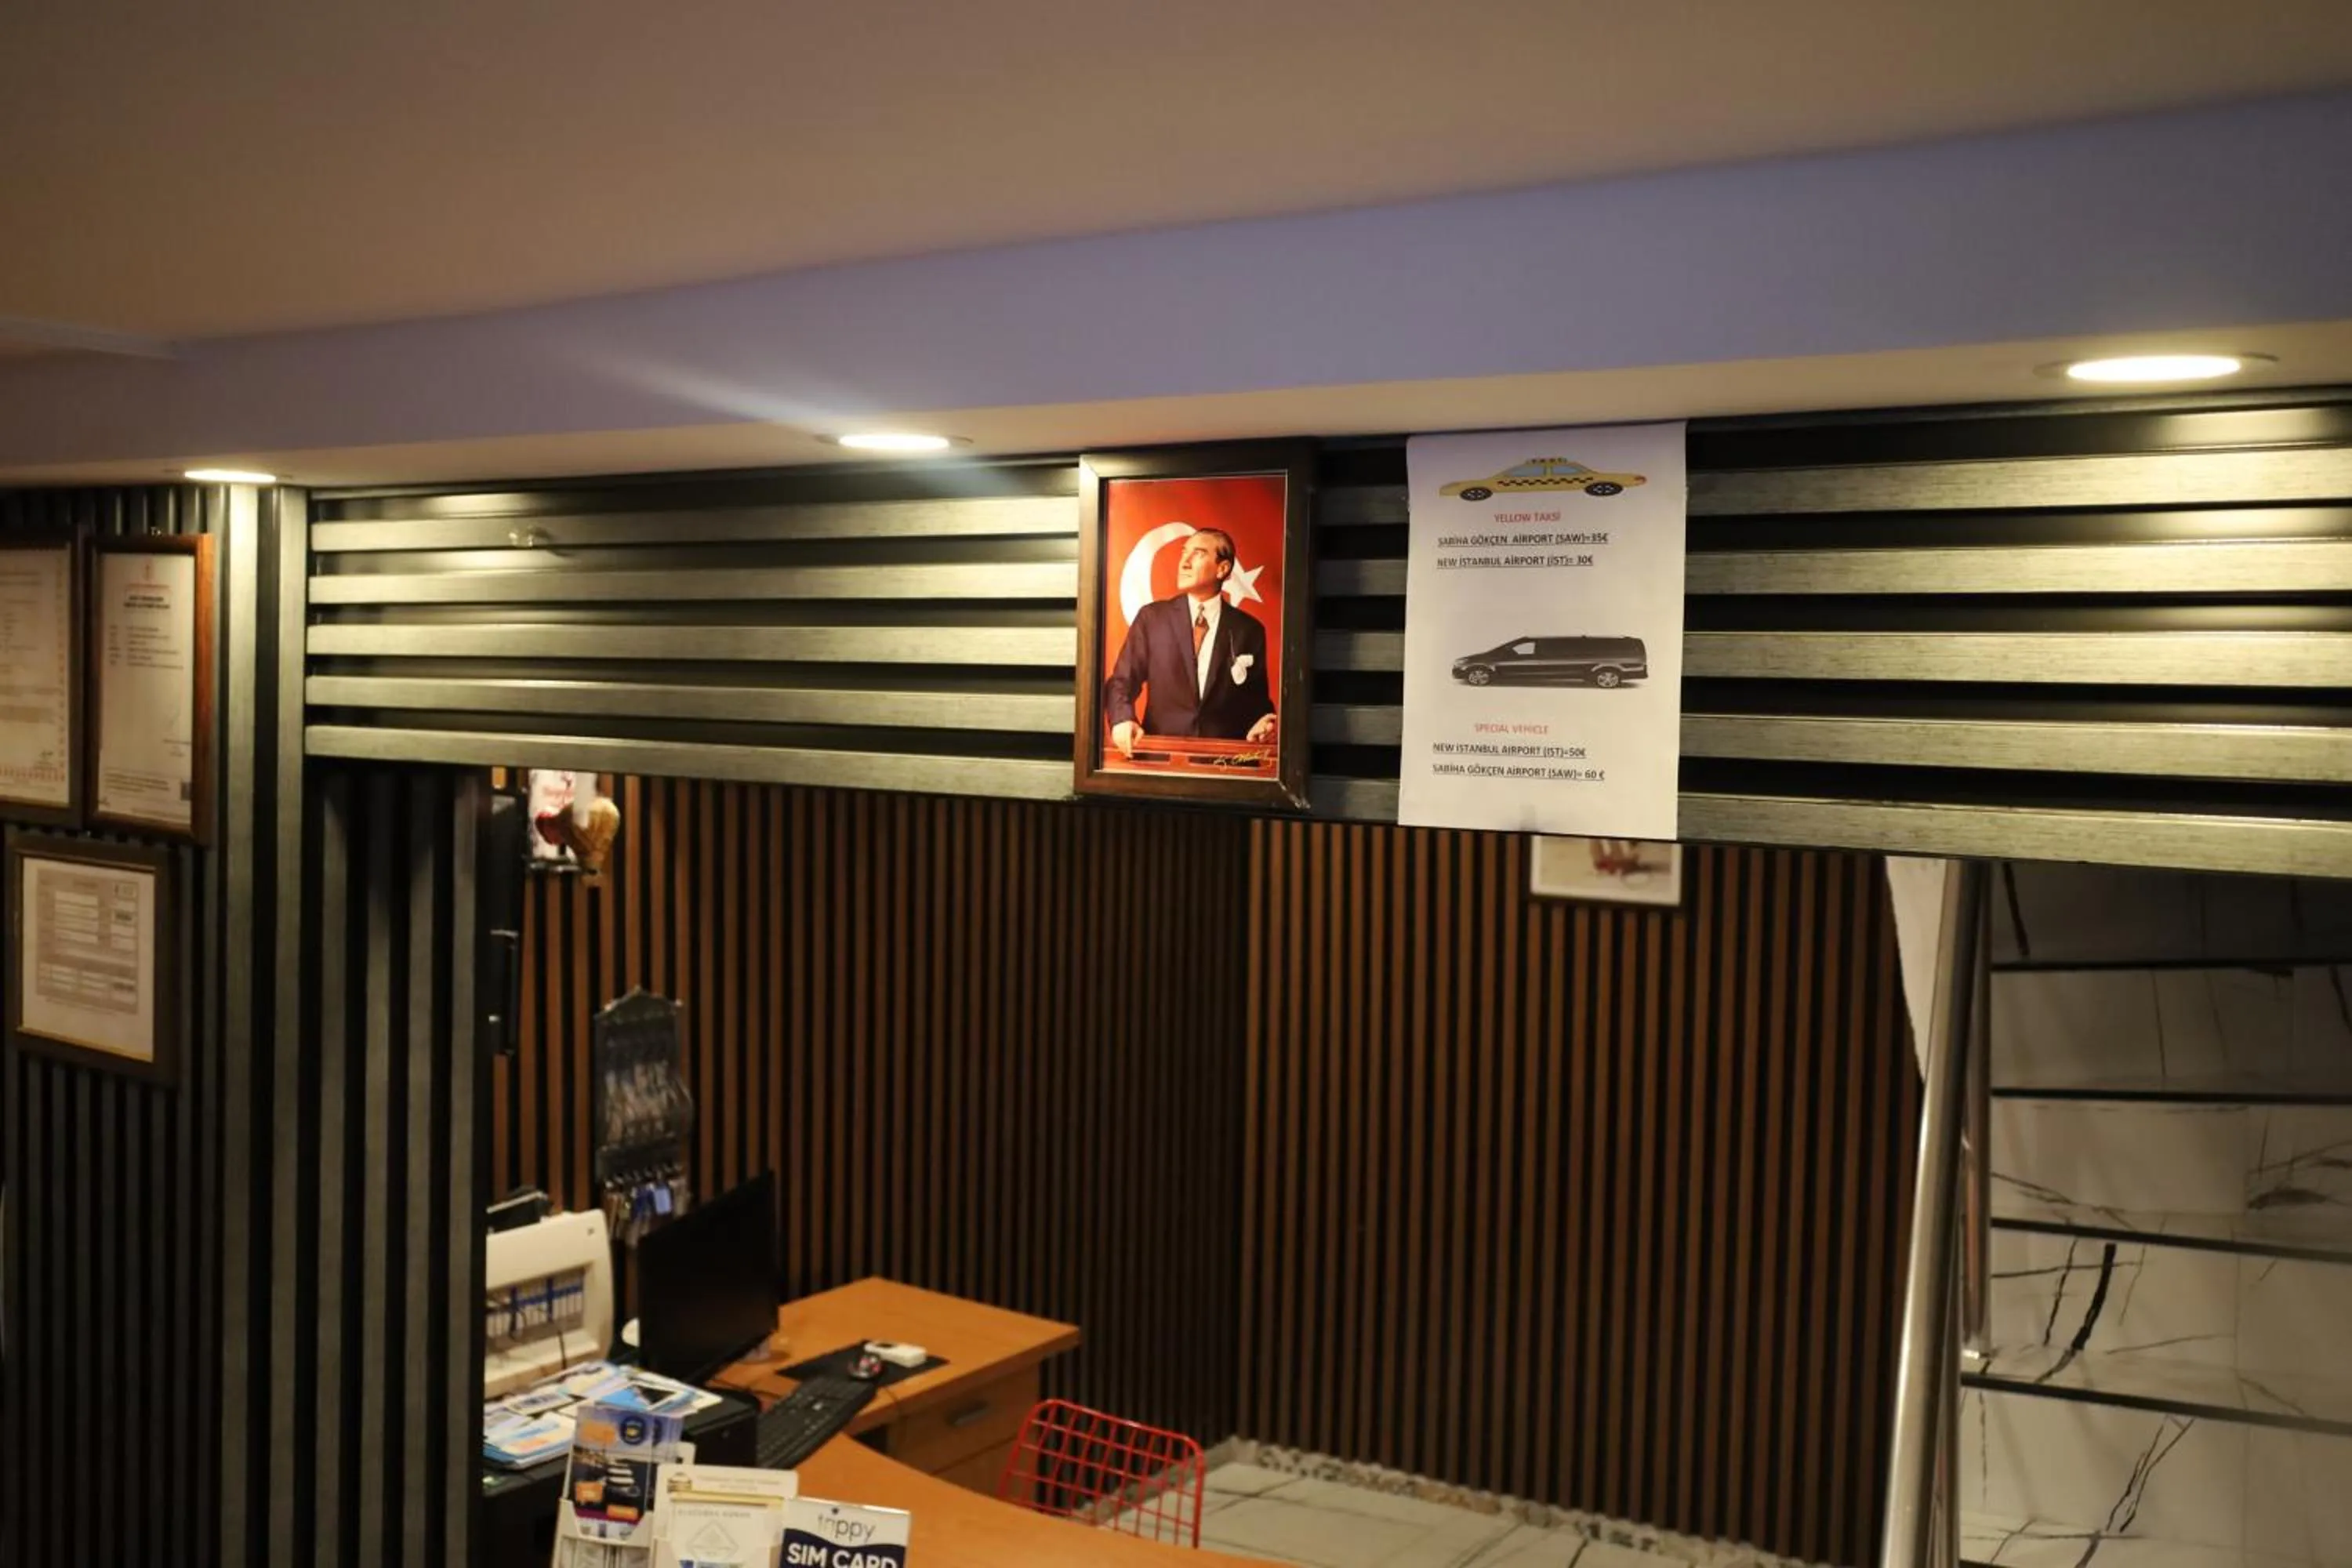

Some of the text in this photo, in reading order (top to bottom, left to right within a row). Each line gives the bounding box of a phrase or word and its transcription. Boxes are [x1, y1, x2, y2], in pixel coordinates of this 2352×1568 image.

[1494, 513, 1531, 523] YELLOW
[1437, 557, 1458, 568] NEW
[1432, 742, 1455, 753] NEW
[786, 1542, 828, 1568] SIM
